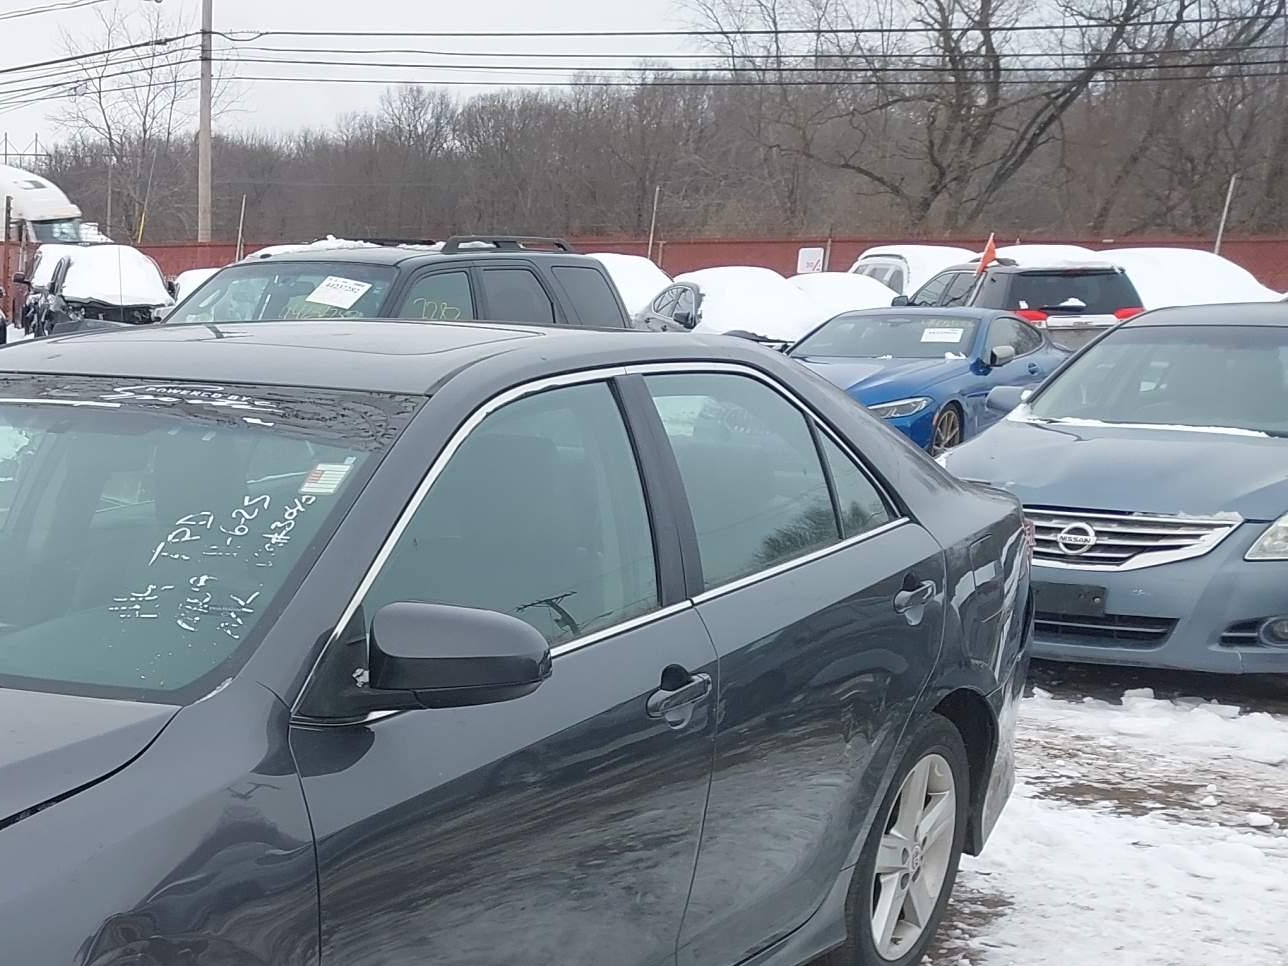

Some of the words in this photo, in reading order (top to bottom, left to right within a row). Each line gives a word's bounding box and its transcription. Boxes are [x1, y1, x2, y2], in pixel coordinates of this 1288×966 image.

[144, 386, 223, 399] POWERED
[226, 394, 252, 402] BY
[1059, 535, 1092, 544] NISSAN
